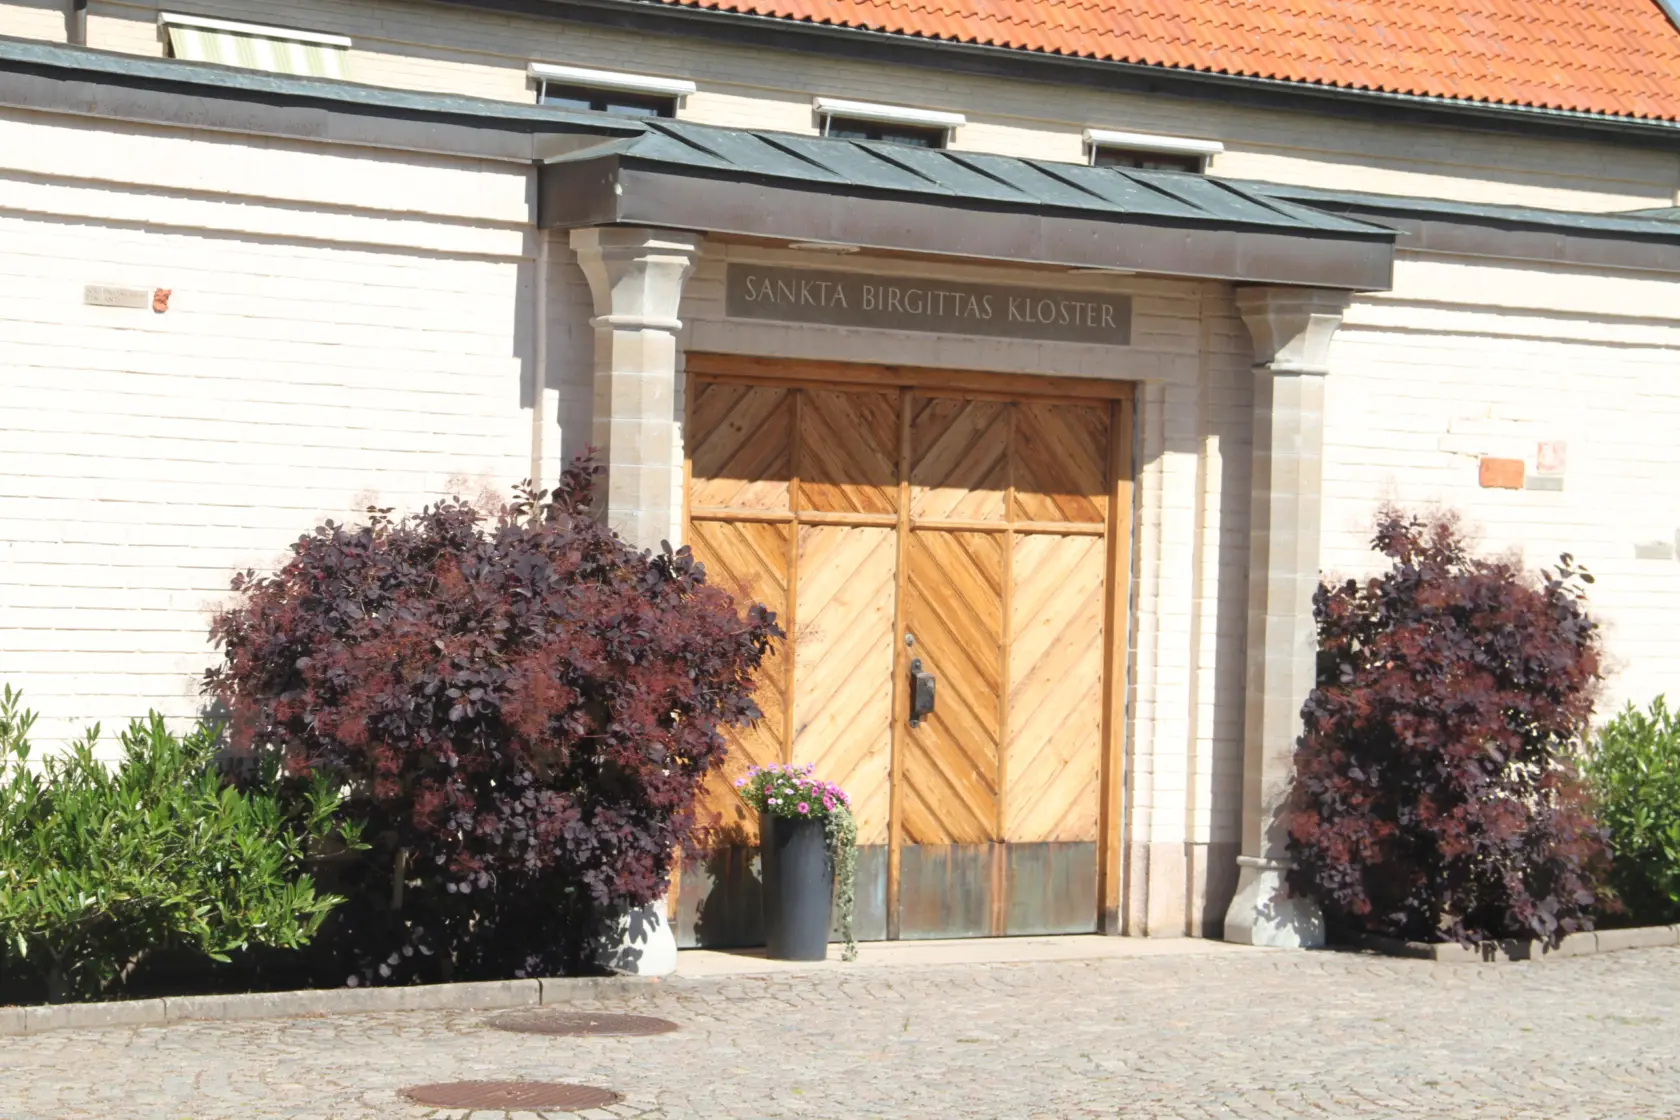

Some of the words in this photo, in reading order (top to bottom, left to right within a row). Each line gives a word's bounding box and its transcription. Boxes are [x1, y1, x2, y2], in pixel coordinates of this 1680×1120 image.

[745, 276, 848, 308] SANKTA
[863, 285, 993, 319] BIRGITTAS
[1008, 297, 1116, 328] KLOSTER
